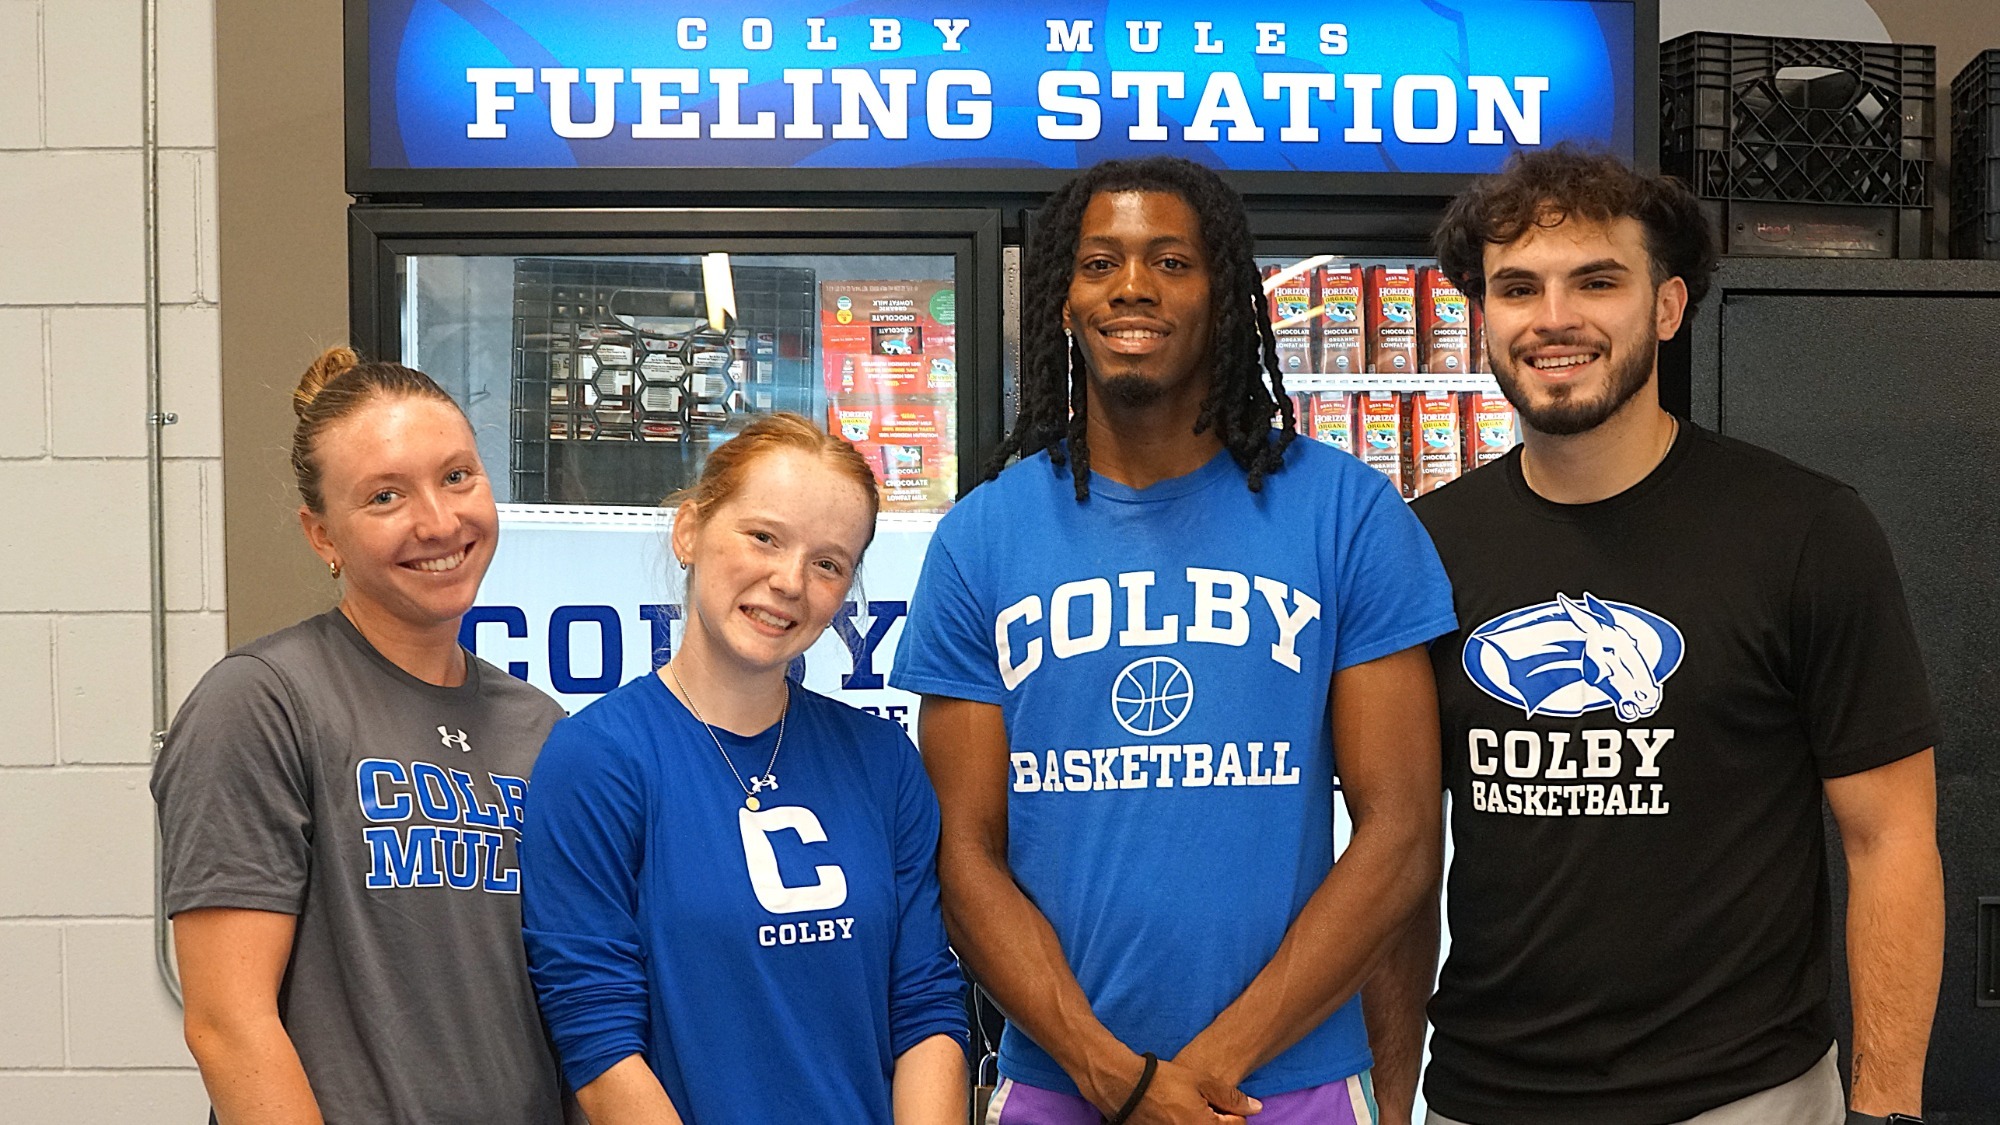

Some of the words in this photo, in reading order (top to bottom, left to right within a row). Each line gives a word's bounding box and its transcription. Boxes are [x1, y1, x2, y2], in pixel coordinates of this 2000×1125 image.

[676, 17, 970, 51] COLBY
[1045, 19, 1349, 56] MULES
[466, 67, 993, 140] FUELING
[1037, 70, 1549, 145] STATION
[1274, 288, 1310, 297] HORIZON
[1322, 287, 1359, 297] HORIZON
[1379, 288, 1415, 297] HORIZON
[1431, 288, 1465, 298] HORIZ
[459, 601, 907, 694] COY
[995, 567, 1321, 691] COLBY
[1010, 742, 1300, 793] BASKETBALL
[1468, 728, 1675, 779] COLBY
[356, 758, 531, 835] COLB
[1472, 781, 1670, 816] BASKETBALL
[363, 826, 522, 894] MUL
[738, 805, 848, 914] C
[758, 917, 855, 946] COLBY
